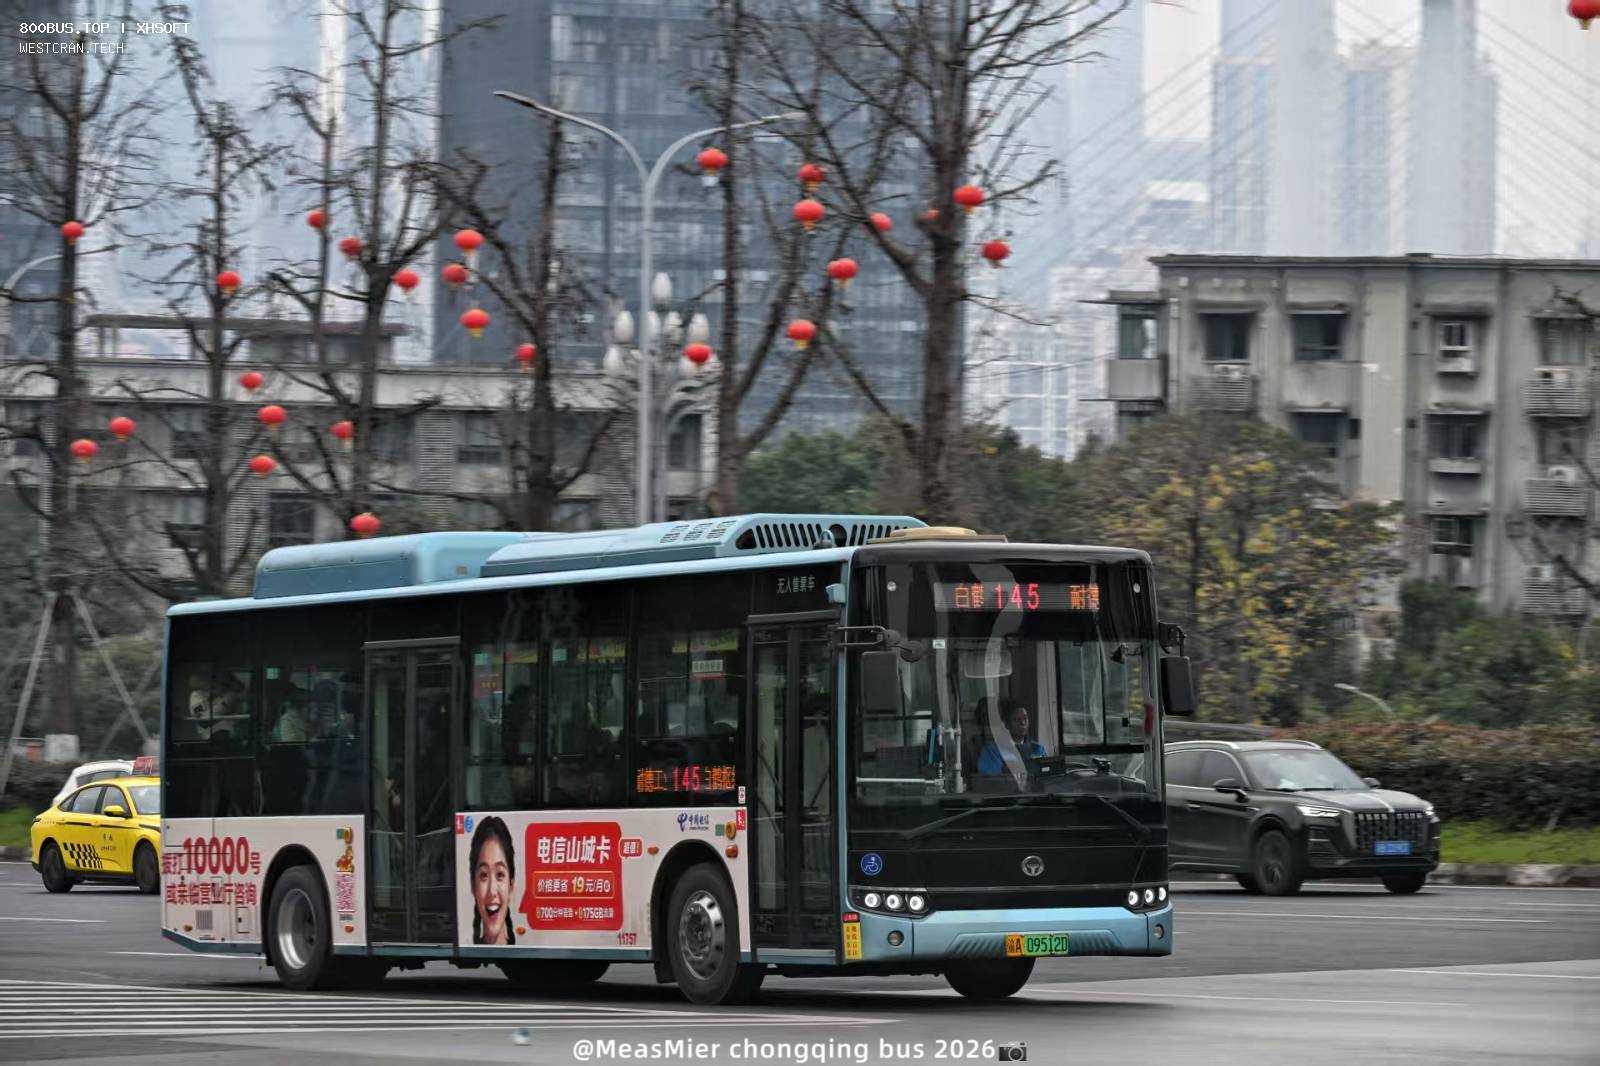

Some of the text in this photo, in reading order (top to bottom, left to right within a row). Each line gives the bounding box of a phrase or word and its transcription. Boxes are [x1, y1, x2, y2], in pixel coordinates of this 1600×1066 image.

[776, 575, 816, 594] 无人售票车
[994, 582, 1041, 610] 145
[673, 765, 701, 793] 145
[688, 813, 710, 826] 中国电信
[537, 836, 611, 864] 电信山城卡
[537, 879, 568, 893] 价格更省
[617, 932, 637, 945] 11757
[1027, 936, 1069, 953] 09512D
